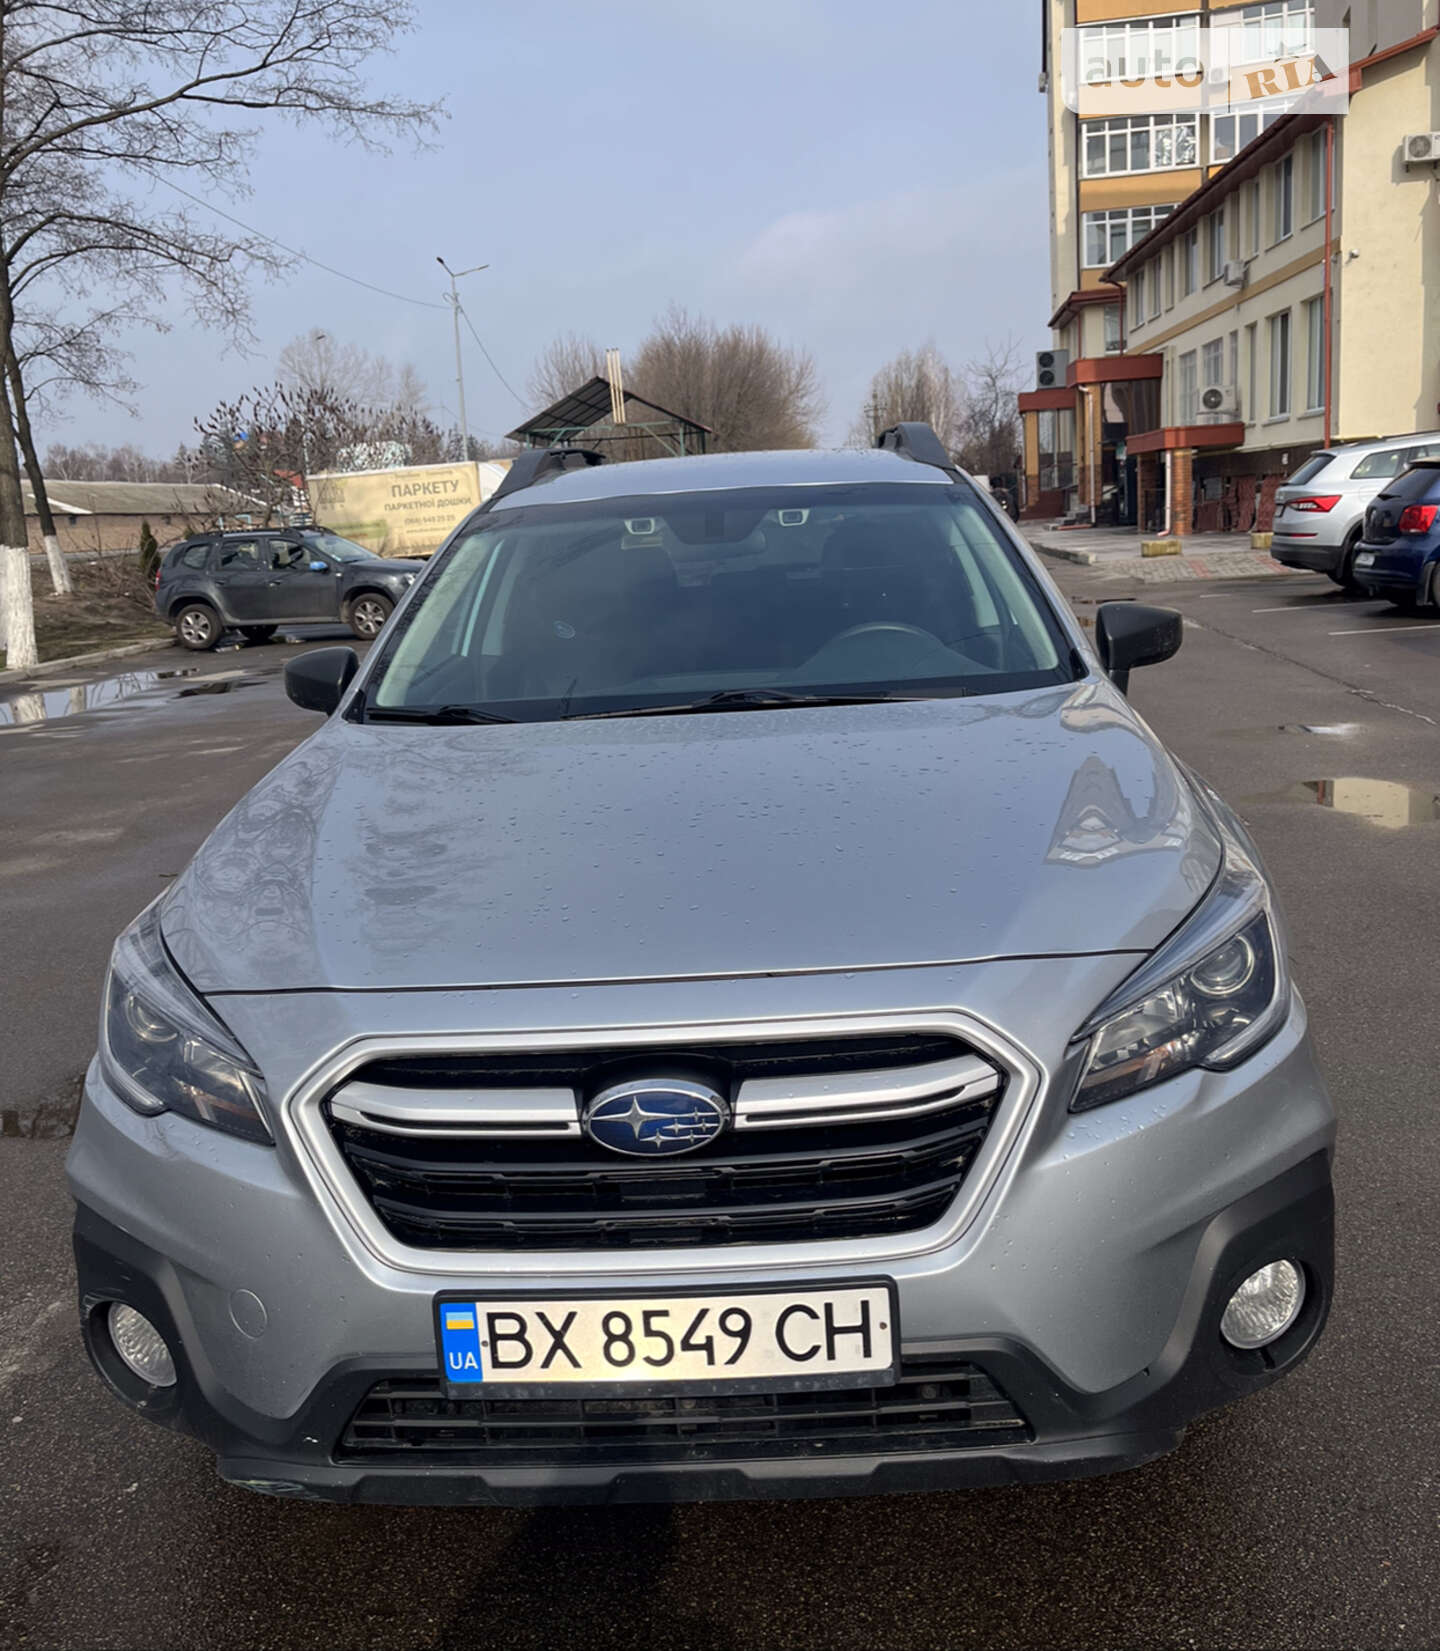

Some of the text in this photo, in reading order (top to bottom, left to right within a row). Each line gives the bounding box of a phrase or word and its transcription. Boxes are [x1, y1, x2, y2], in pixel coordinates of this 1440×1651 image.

[391, 479, 459, 497] ПАРКЕТУ
[486, 1300, 873, 1369] BX 8549 CH
[449, 1351, 479, 1370] UA
